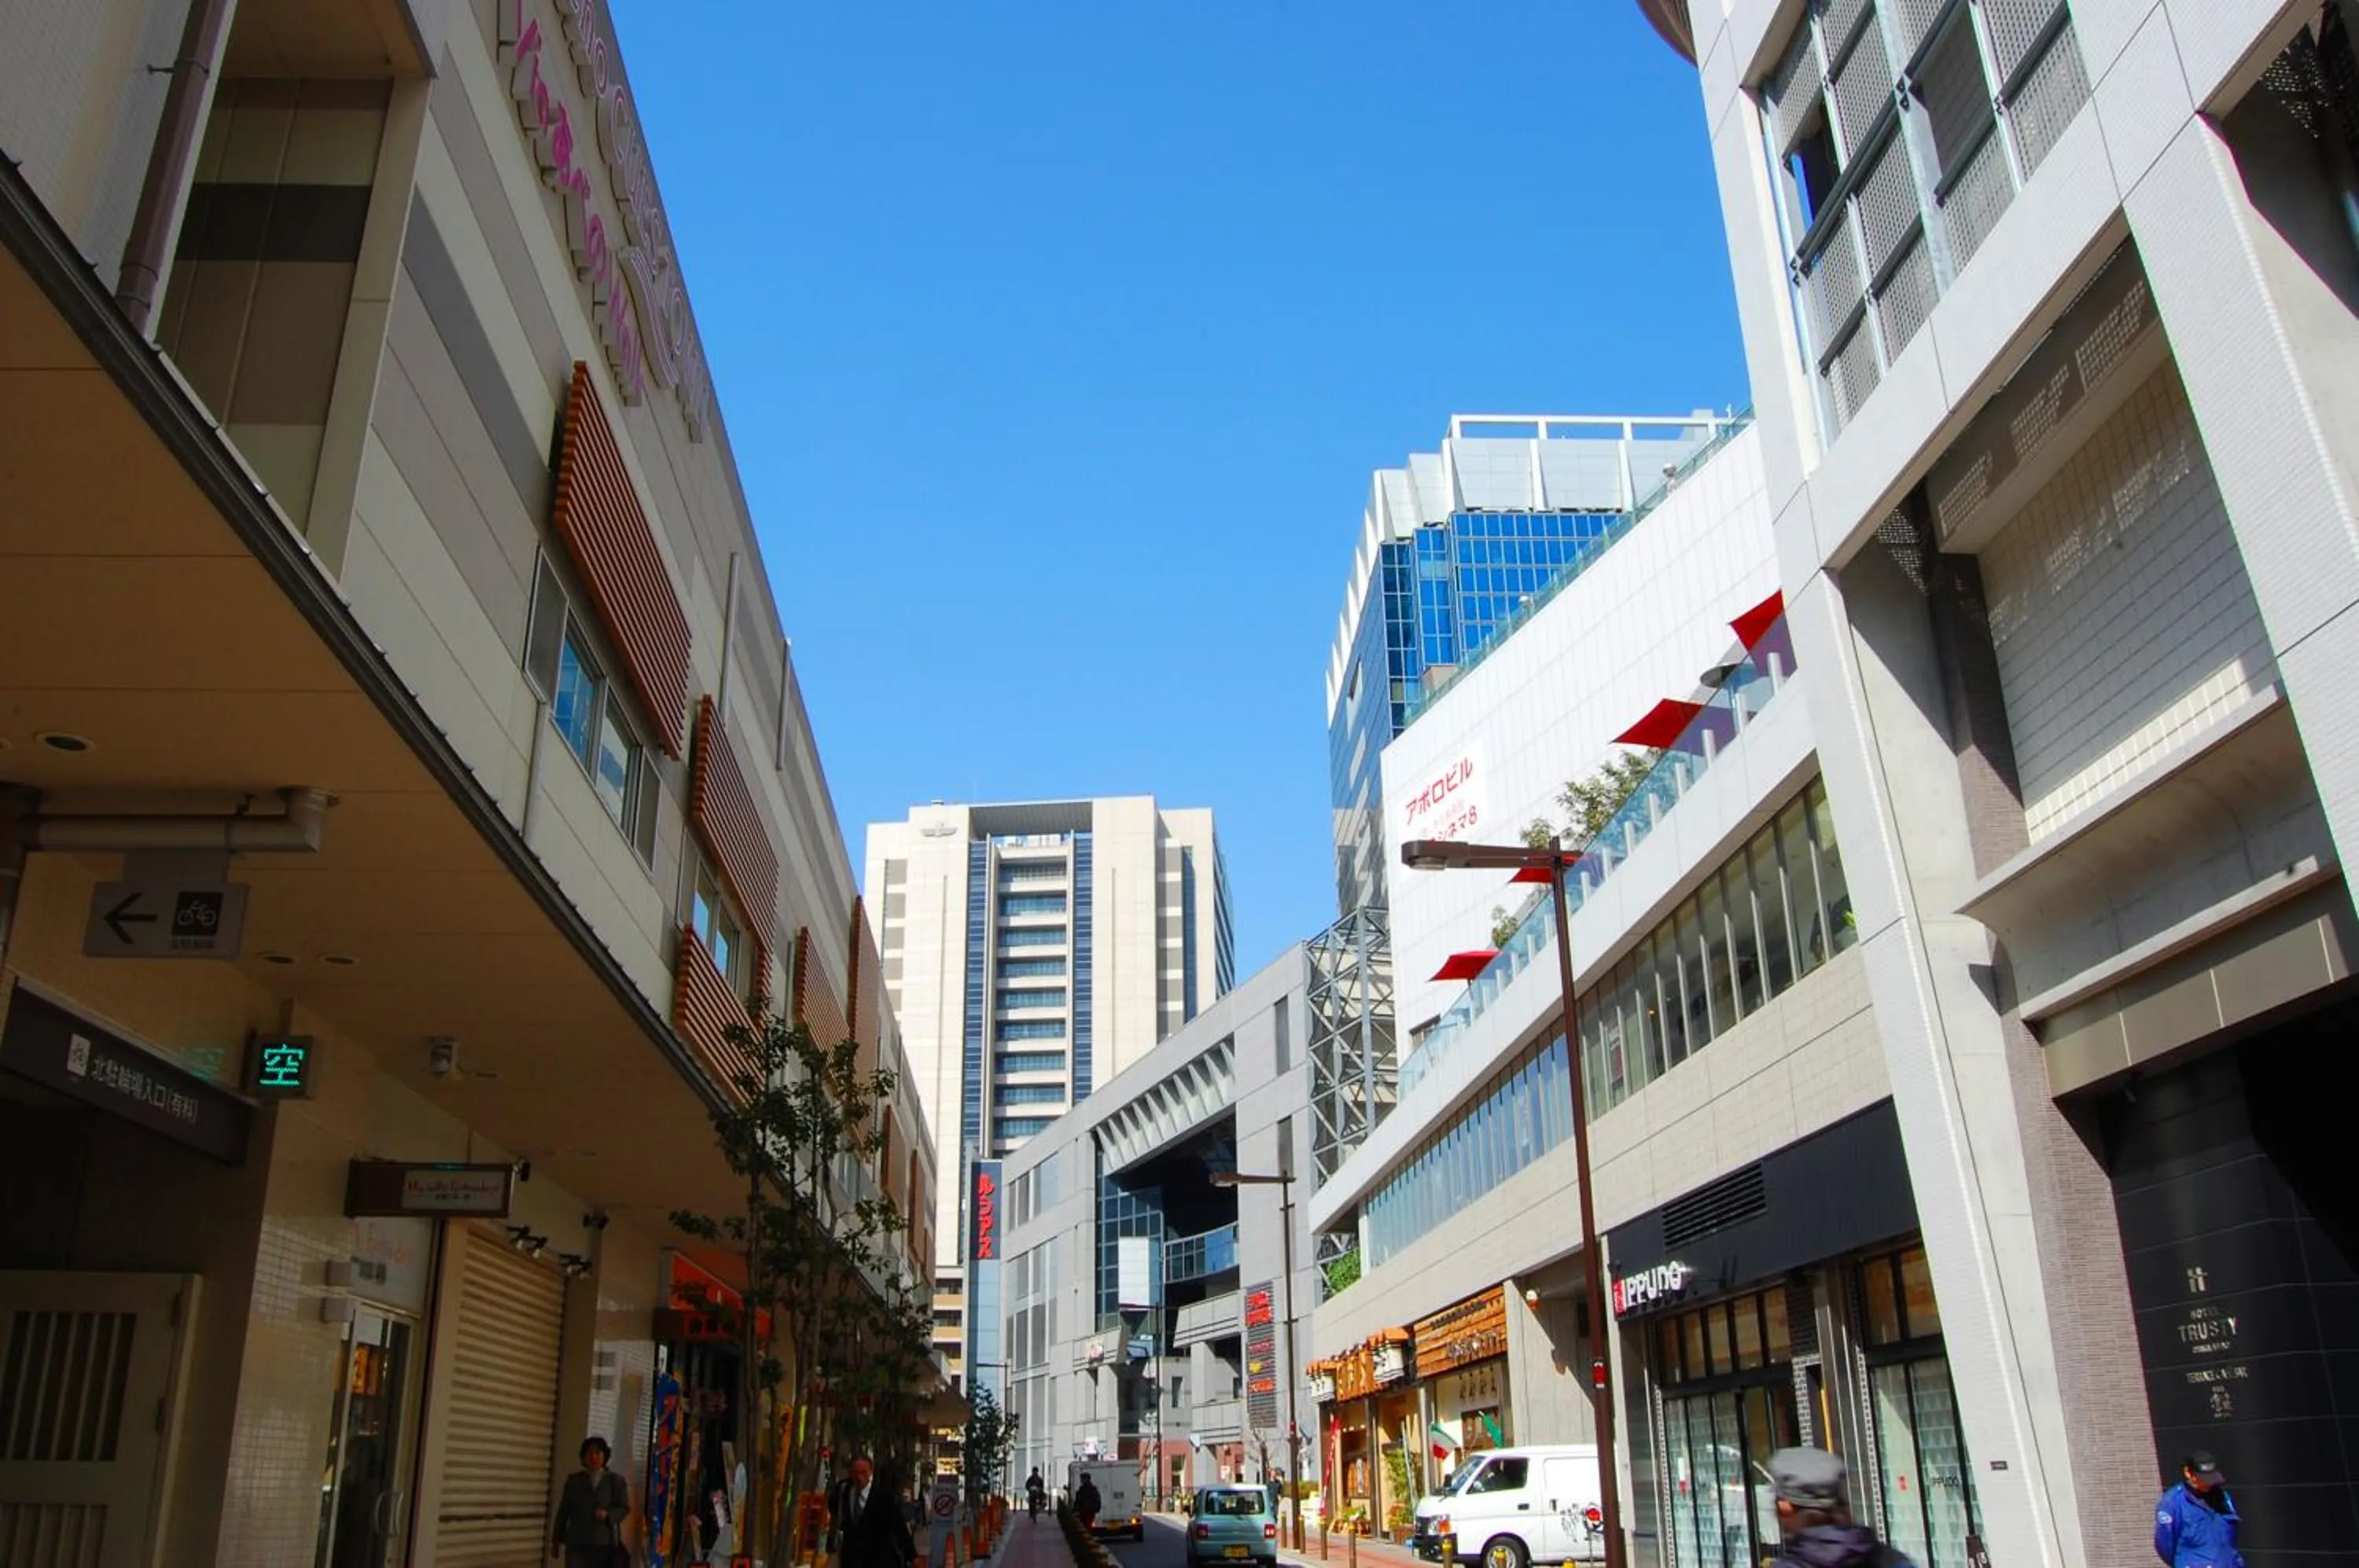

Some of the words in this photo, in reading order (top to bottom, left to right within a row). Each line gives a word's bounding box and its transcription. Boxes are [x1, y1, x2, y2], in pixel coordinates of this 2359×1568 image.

[1405, 757, 1473, 826] アポロビル
[258, 1043, 306, 1086] 空
[2177, 1316, 2237, 1344] TRUSTY
